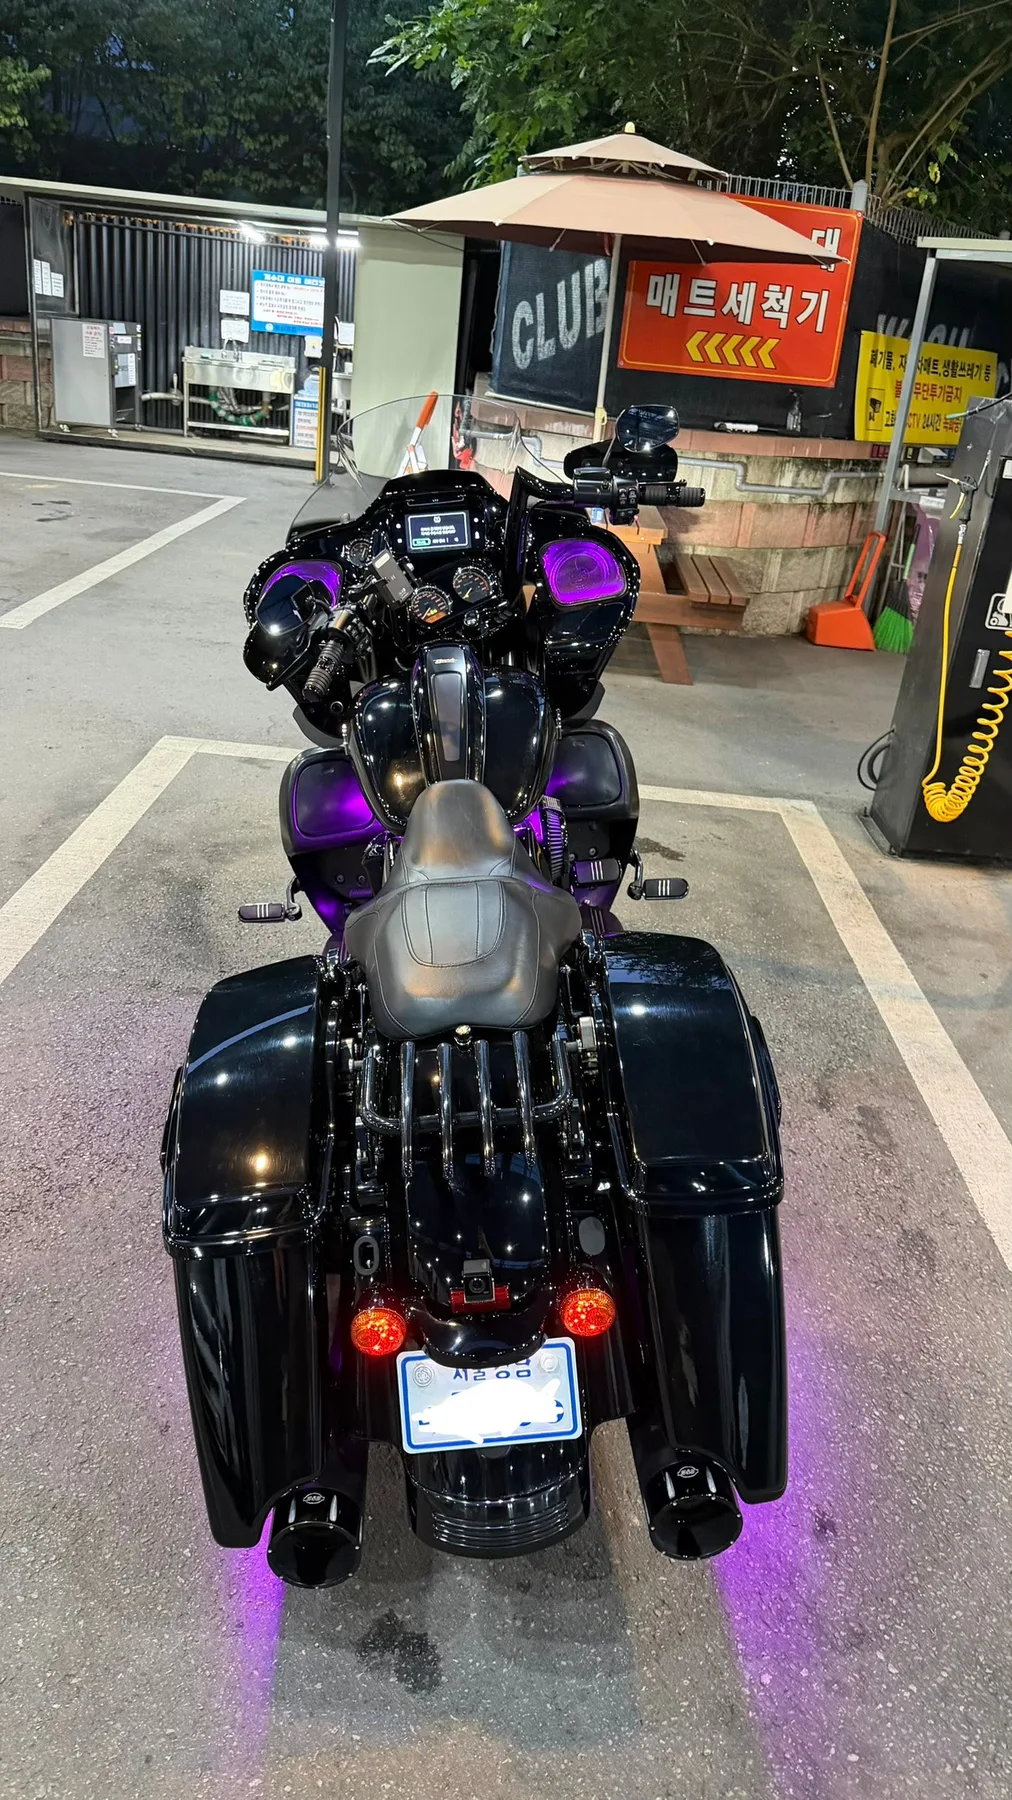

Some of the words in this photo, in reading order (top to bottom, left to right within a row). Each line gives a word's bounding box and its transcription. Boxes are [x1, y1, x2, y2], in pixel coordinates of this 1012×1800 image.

[512, 258, 609, 370] CLUB
[646, 273, 829, 333] 매트세척기
[984, 364, 991, 382] 등
[913, 382, 963, 404] 무단투기금지
[907, 412, 921, 429] CTV
[922, 412, 942, 432] 24시간
